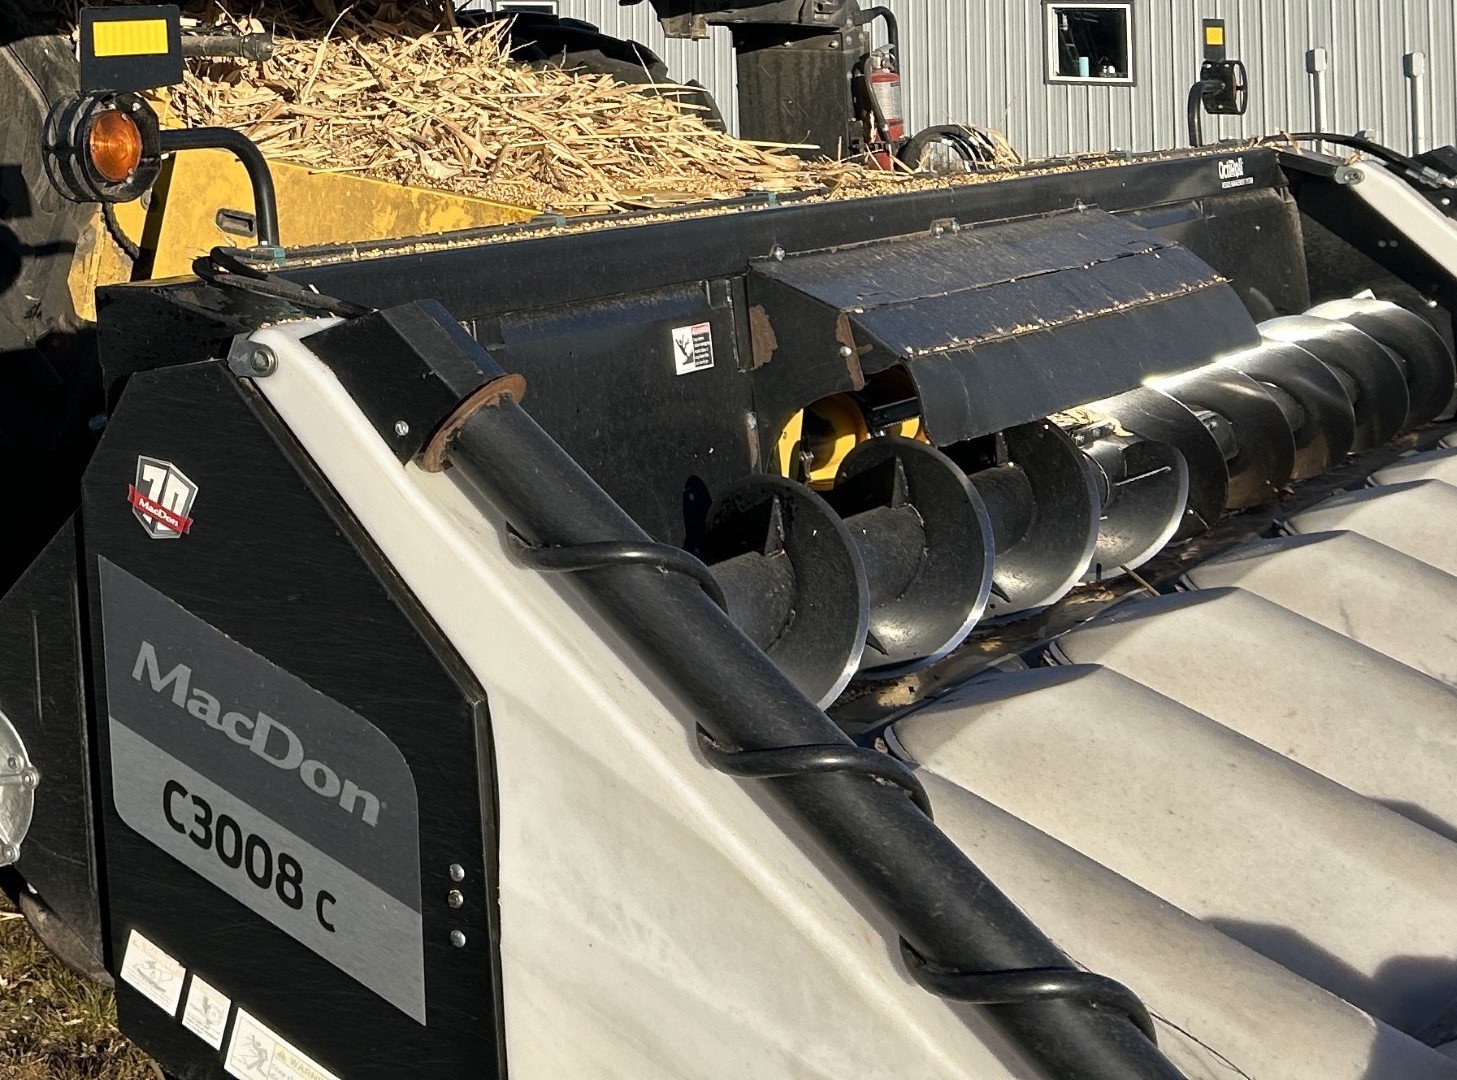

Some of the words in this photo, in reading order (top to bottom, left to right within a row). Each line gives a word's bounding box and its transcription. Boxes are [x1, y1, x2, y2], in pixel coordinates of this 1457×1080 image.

[138, 497, 179, 527] MacDon
[142, 463, 190, 531] 70
[132, 640, 381, 827] MacDon
[162, 779, 304, 910] C3008
